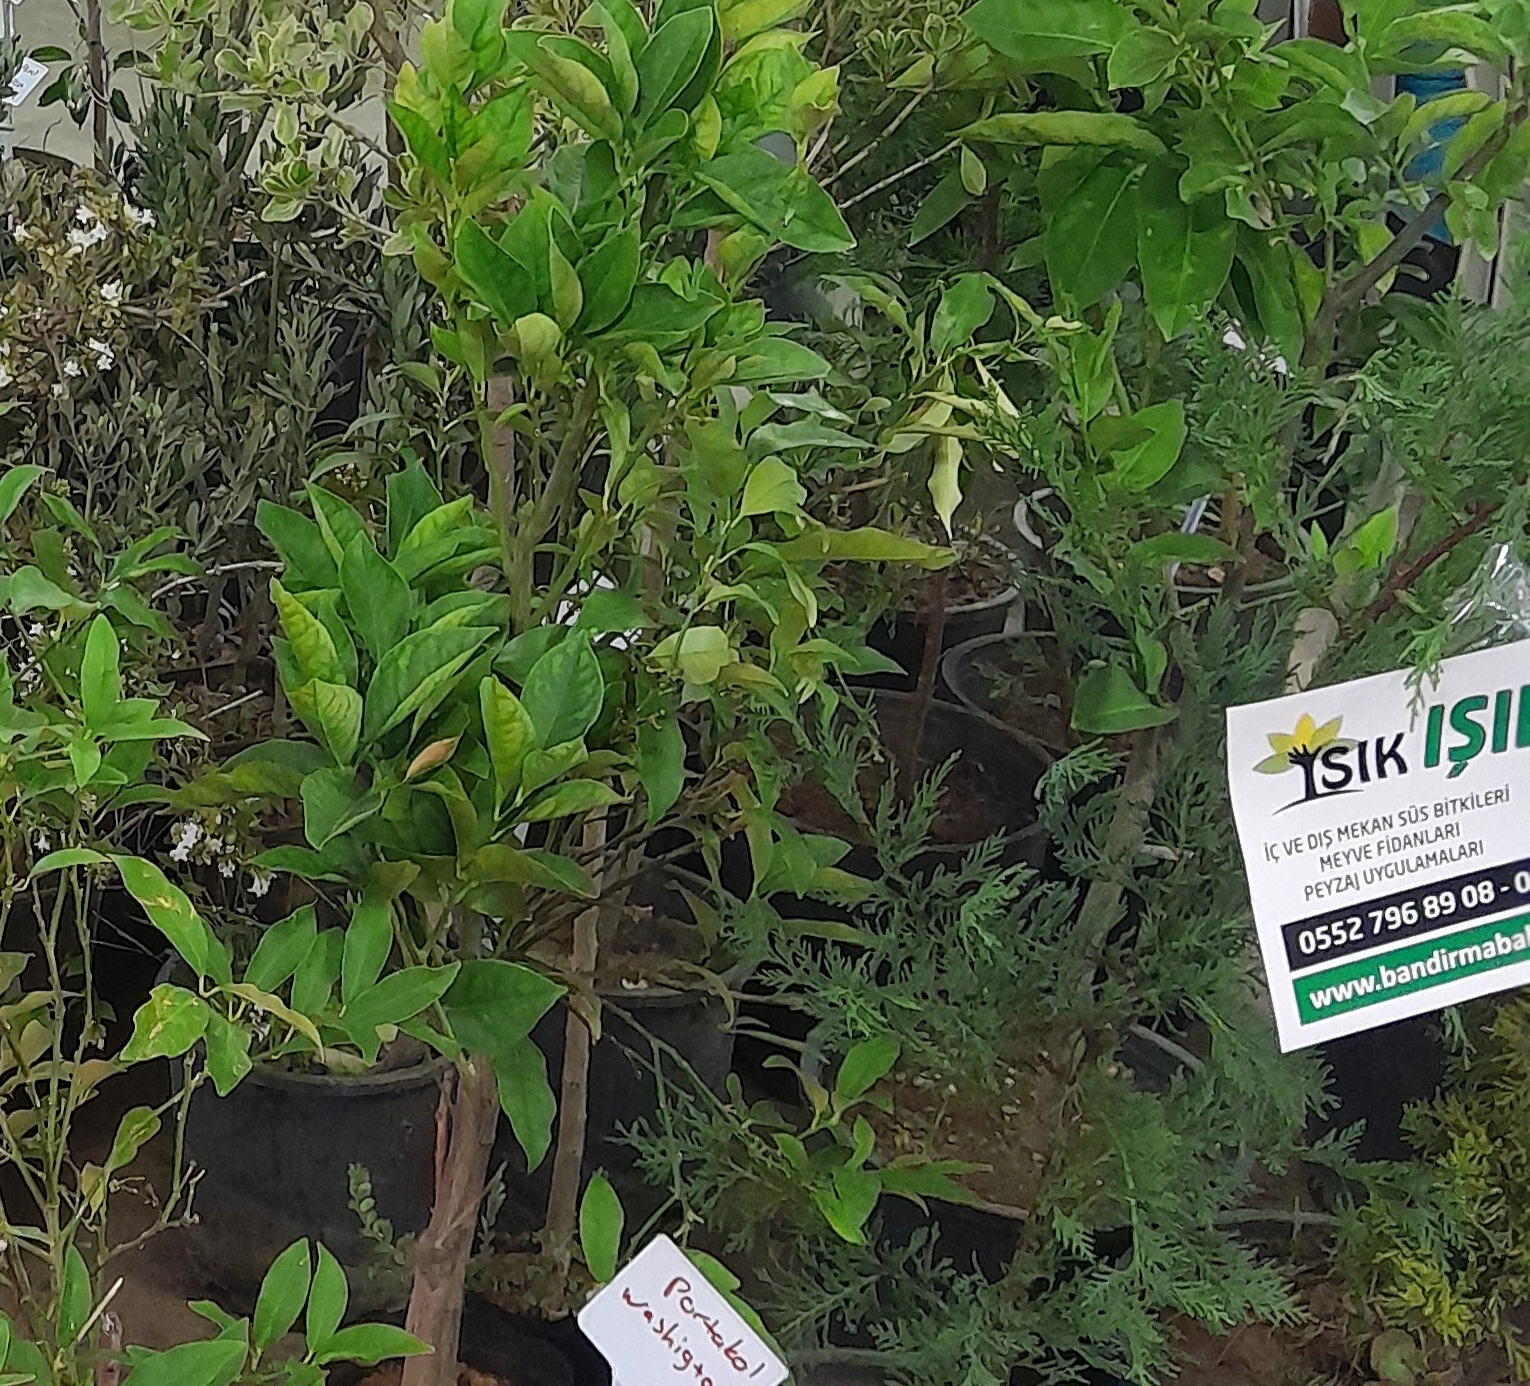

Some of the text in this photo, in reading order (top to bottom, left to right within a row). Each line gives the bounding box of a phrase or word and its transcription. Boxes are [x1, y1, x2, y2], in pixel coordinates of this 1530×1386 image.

[1264, 783, 1510, 863] İÇ VE DIŞ MEKAN SÜS BİTKİLERİ
[1320, 821, 1460, 872] MEYVE FİDANLARI
[1304, 840, 1484, 901] PEYZAJ UYGULAMALARI
[1299, 917, 1364, 954] 0552
[1368, 902, 1419, 935] 796
[1422, 891, 1456, 919] 89
[1461, 880, 1495, 908] 08
